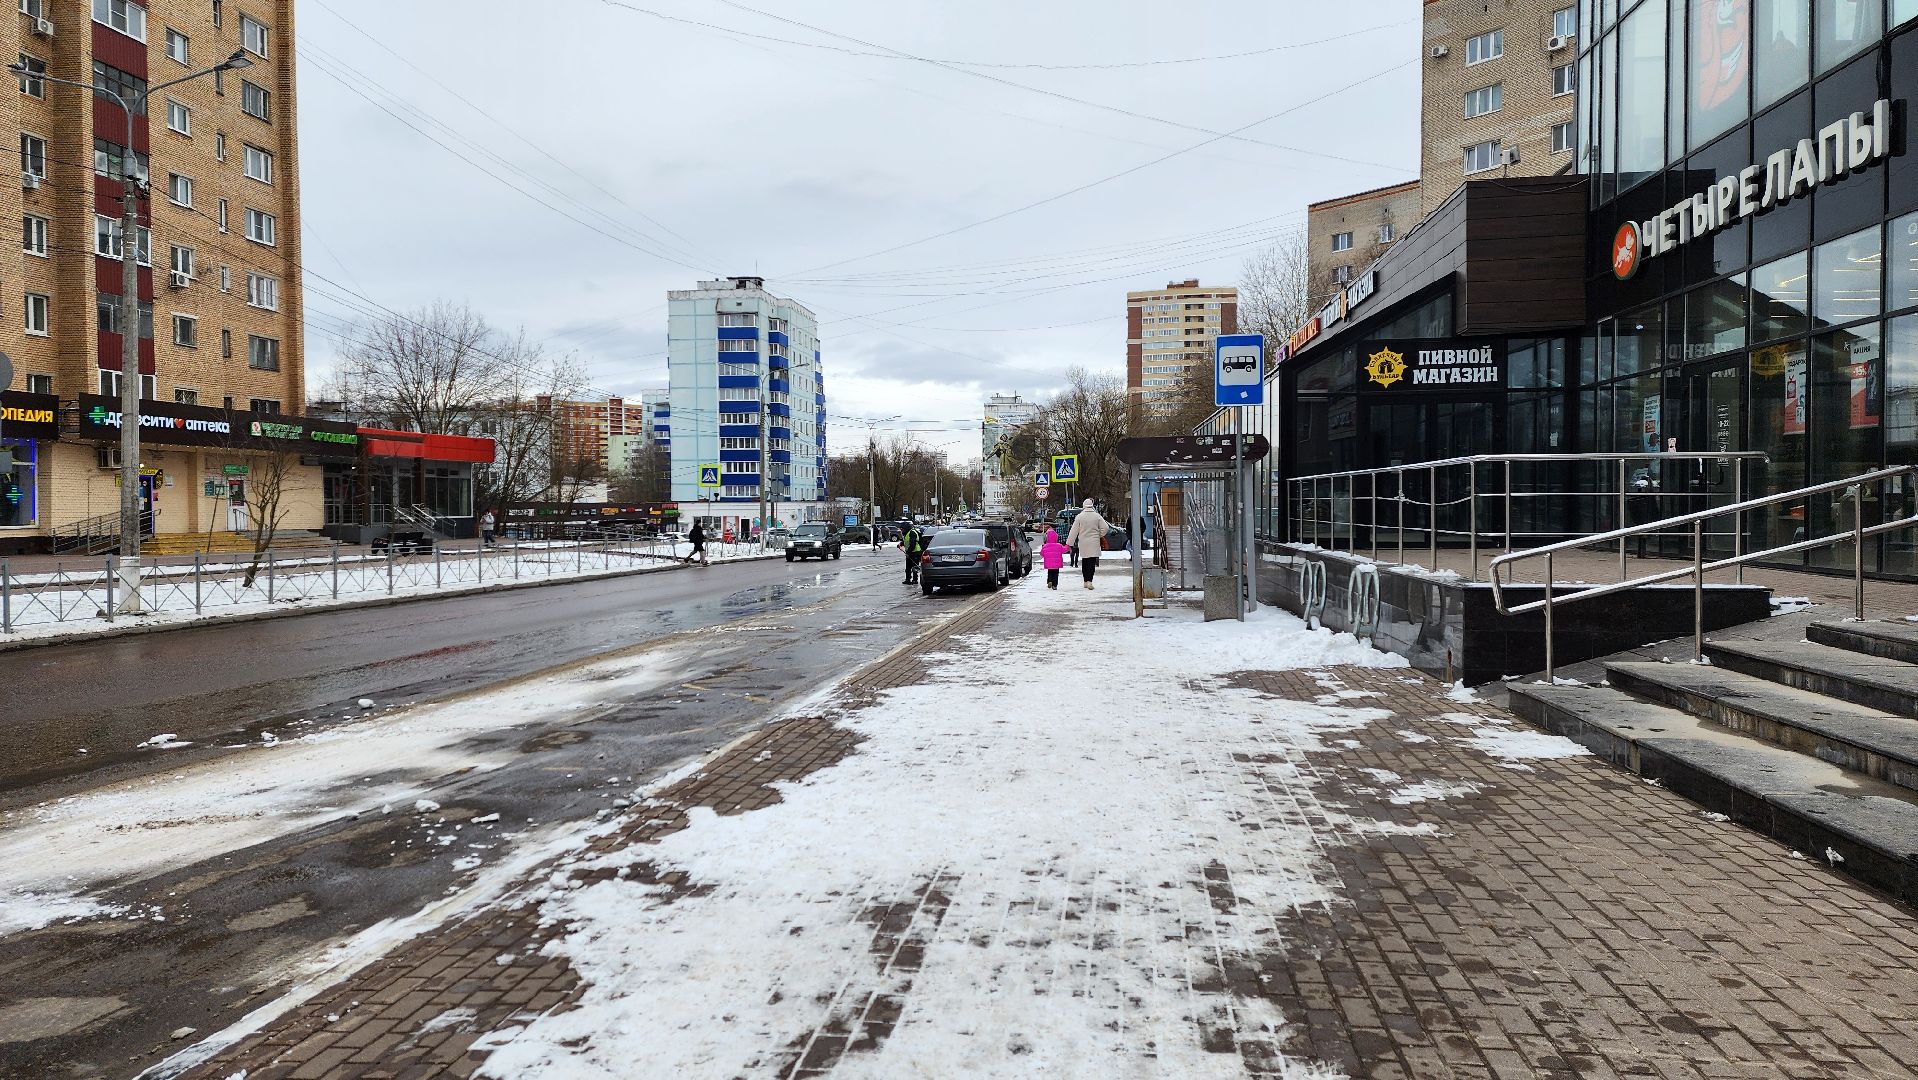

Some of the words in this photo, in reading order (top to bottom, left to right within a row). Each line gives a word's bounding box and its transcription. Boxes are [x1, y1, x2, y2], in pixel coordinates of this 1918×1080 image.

[1418, 345, 1492, 366] ПИВНОЙ
[1412, 366, 1498, 385] МАГАЗИН
[185, 419, 230, 434] аптека
